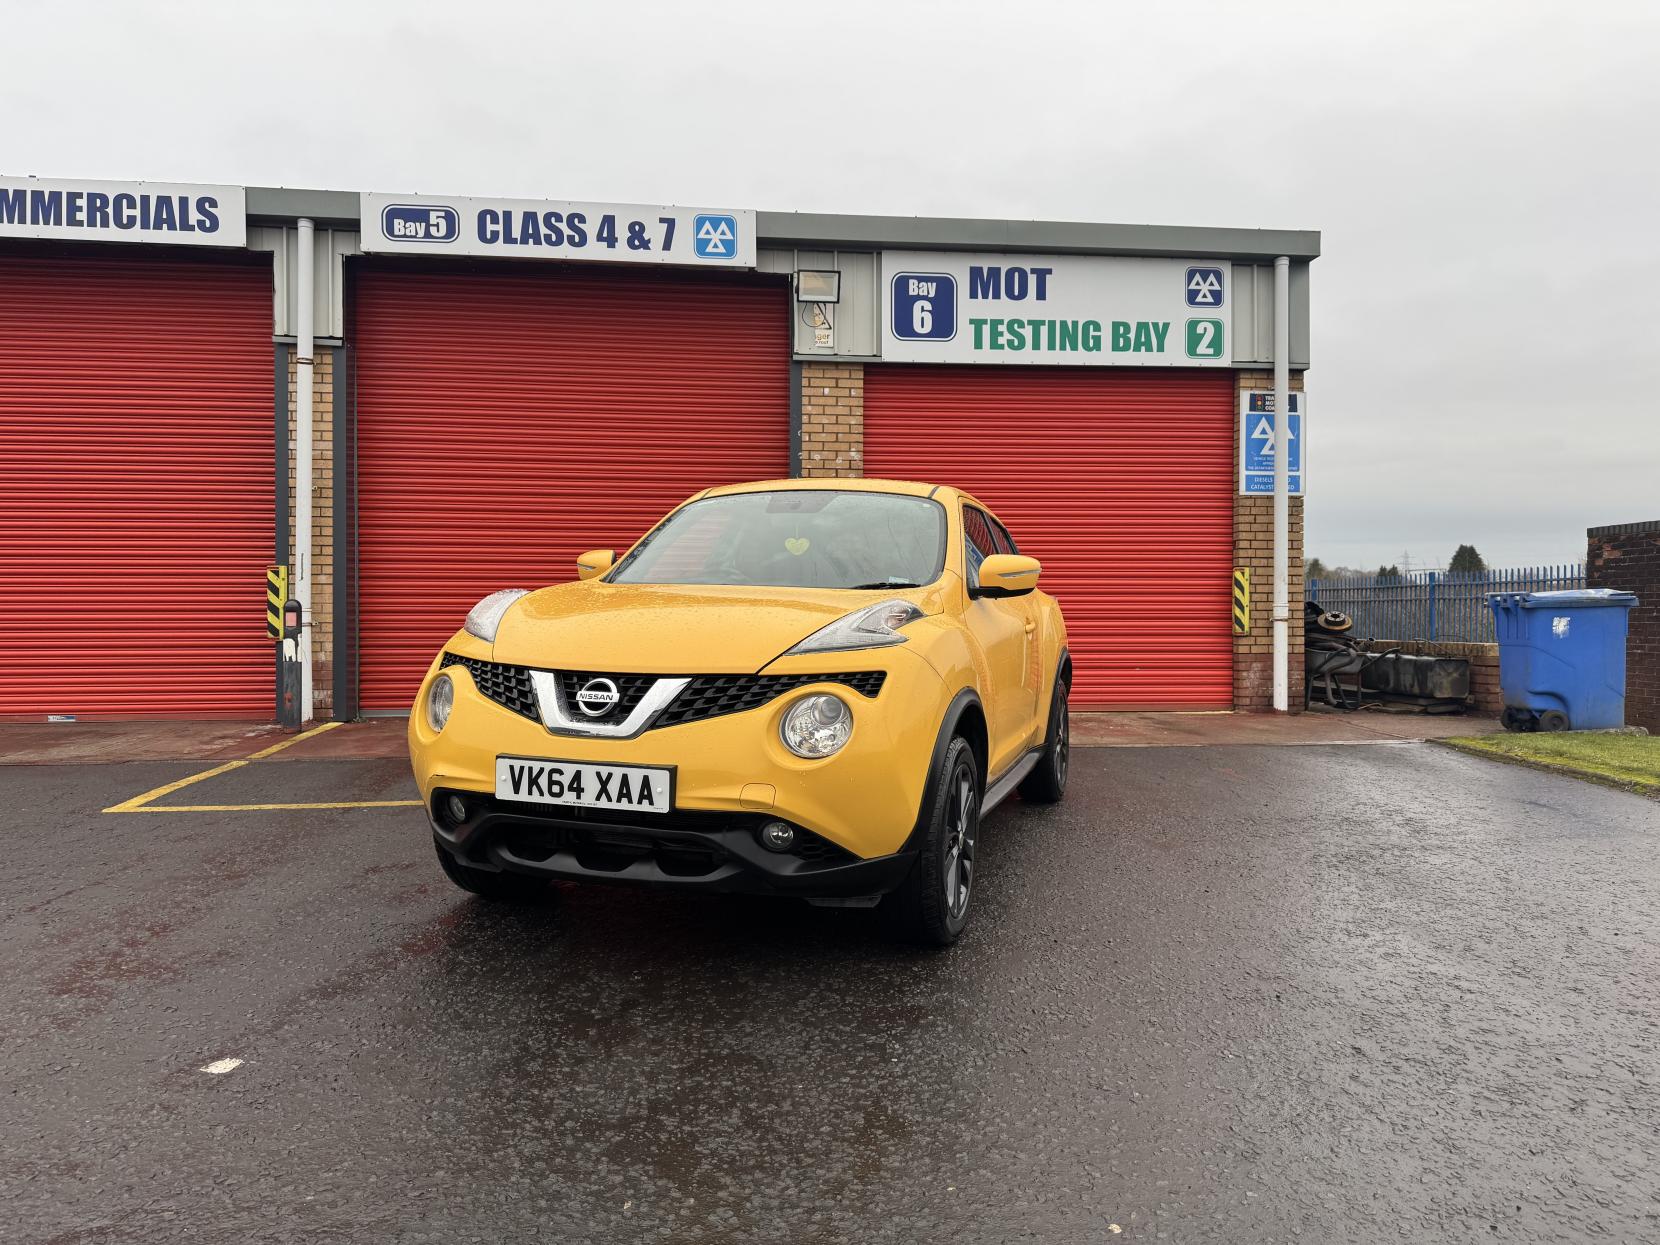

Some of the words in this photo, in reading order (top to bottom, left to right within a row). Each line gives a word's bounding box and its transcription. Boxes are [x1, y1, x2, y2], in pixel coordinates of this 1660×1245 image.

[0, 188, 220, 234] MMERCIALS
[393, 218, 426, 239] Bay
[429, 210, 447, 238] 5
[477, 208, 588, 248] CLASS
[595, 214, 619, 249] 4
[627, 220, 652, 251] &
[658, 216, 677, 252] 7
[908, 278, 937, 298] Bay
[968, 265, 1053, 302] MOT
[912, 299, 933, 335] 6
[968, 318, 1102, 353] TESTING
[1111, 320, 1171, 354] BAY
[1196, 321, 1215, 355] 2
[578, 692, 615, 703] NISSAN
[508, 764, 585, 800] VK64
[594, 770, 655, 807] XAA
